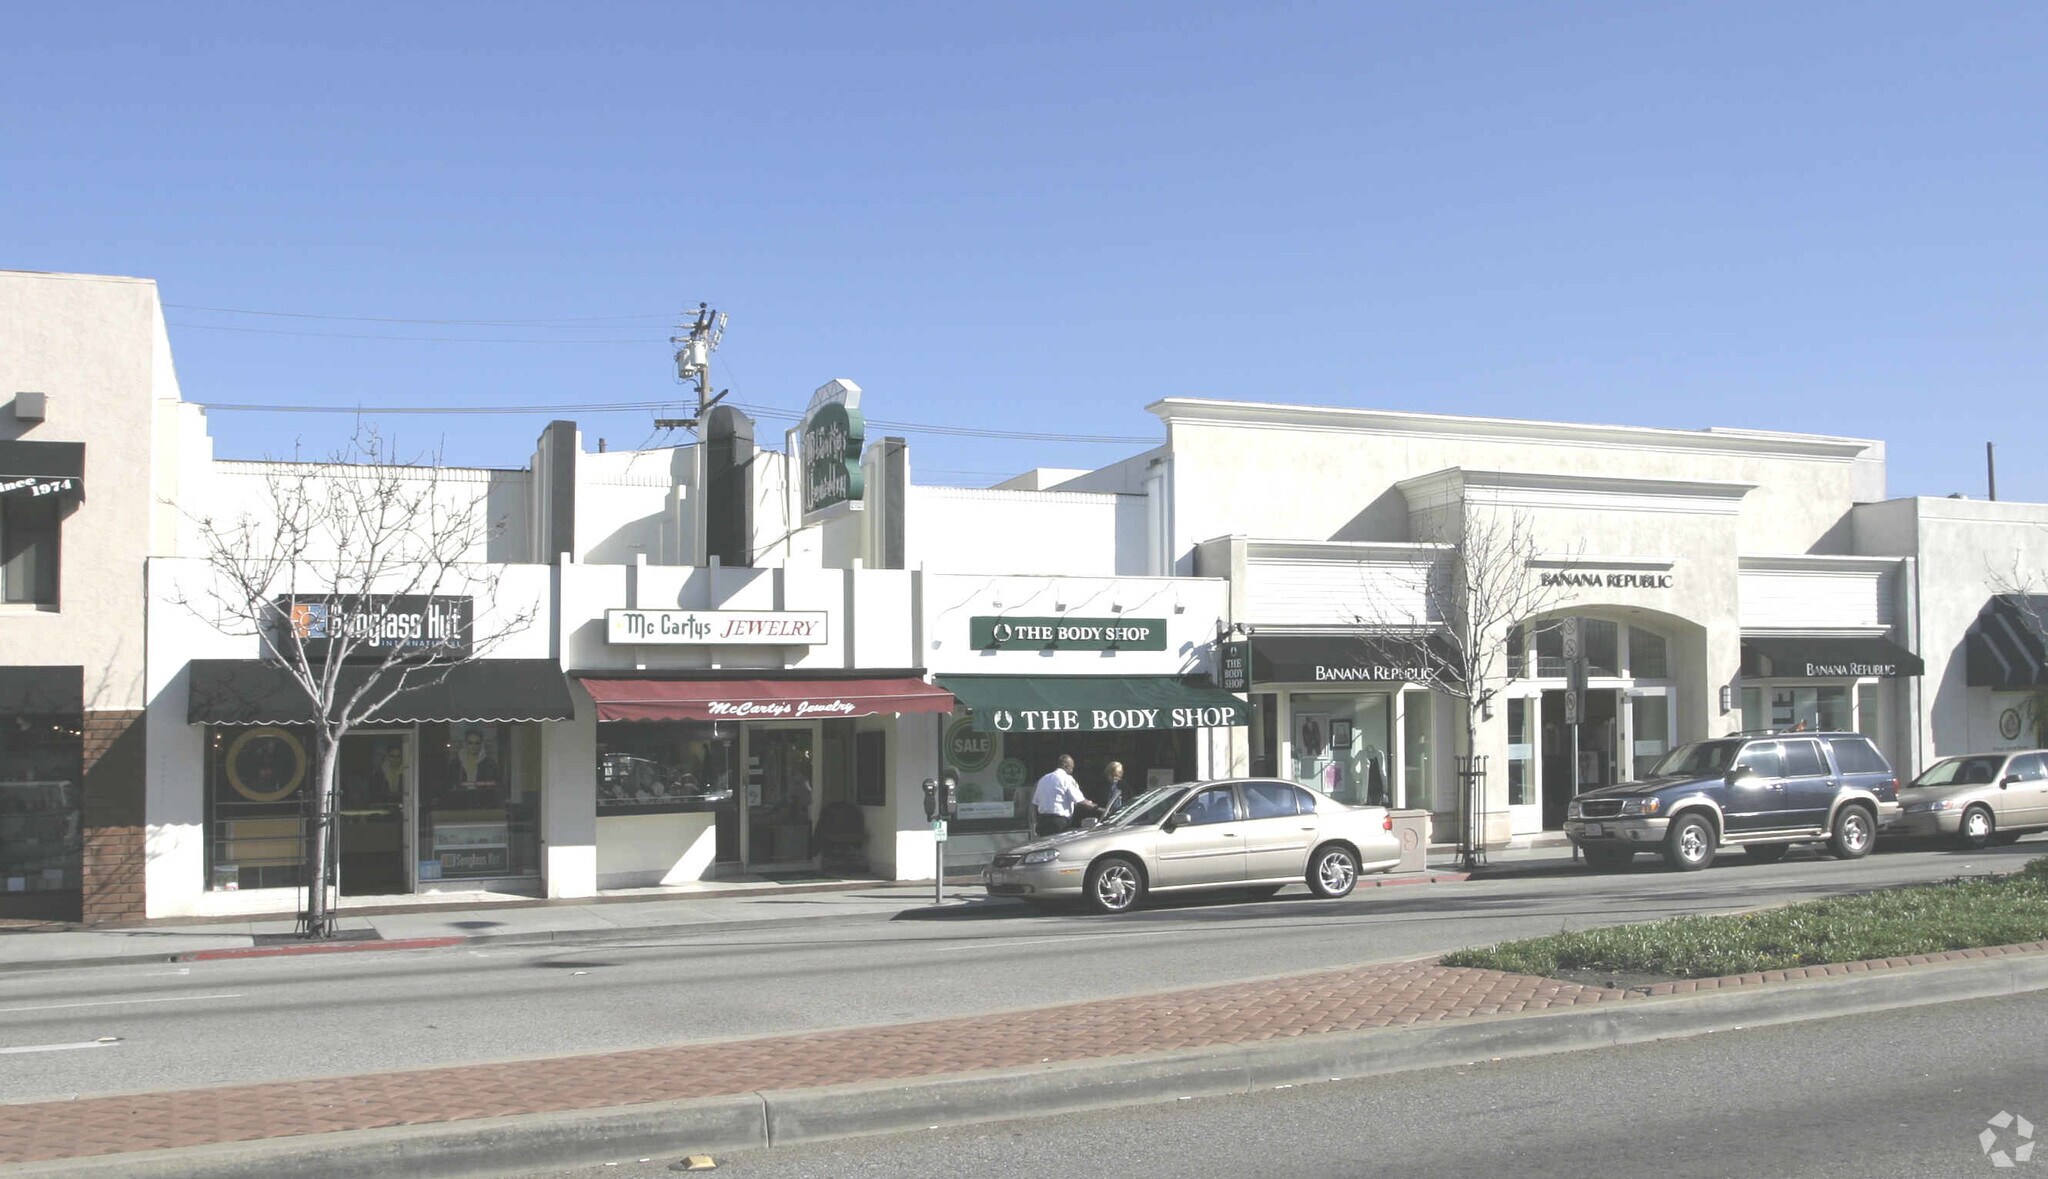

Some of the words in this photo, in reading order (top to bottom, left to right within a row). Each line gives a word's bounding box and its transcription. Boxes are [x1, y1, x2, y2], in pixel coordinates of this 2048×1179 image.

[0, 478, 36, 493] ince
[31, 479, 72, 497] 1974
[1541, 572, 1603, 588] BANANA
[1606, 573, 1674, 588] REPUBLIC
[428, 604, 462, 639] Hut
[720, 620, 818, 638] JEWELRY
[1015, 626, 1053, 640] THE
[1057, 627, 1103, 640] BODY
[1106, 628, 1150, 641] SHOP
[381, 640, 461, 649] INTRNATIAL
[1226, 659, 1242, 669] THE
[1224, 669, 1244, 679] BODY
[1224, 678, 1245, 689] SHOP
[708, 701, 792, 716] McCarty's
[795, 700, 856, 717] Jewelry
[1021, 710, 1080, 730] THE
[1092, 708, 1160, 730] BODY
[954, 738, 990, 753] SALE
